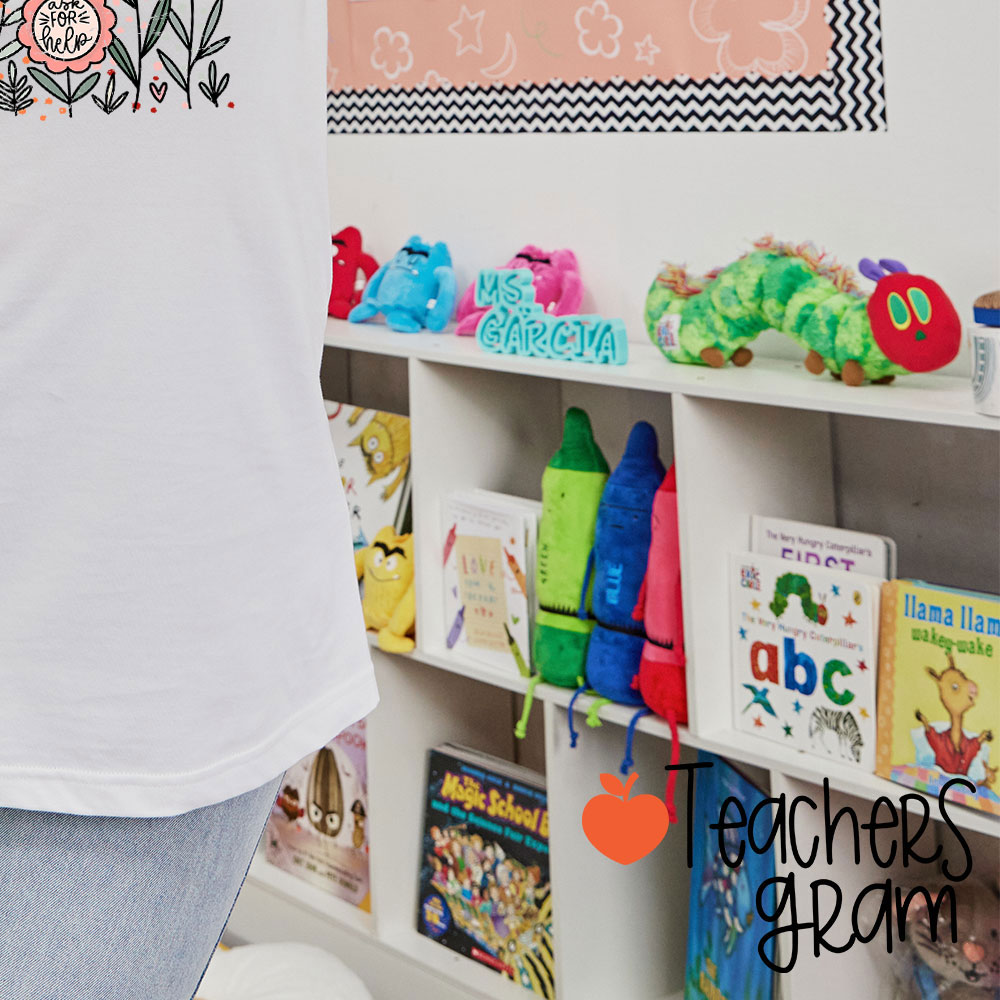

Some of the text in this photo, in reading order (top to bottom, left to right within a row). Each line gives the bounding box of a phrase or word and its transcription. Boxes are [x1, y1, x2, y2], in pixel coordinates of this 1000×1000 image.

[39, 25, 92, 54] help
[50, 11, 77, 27] FOR
[477, 308, 622, 365] GARCIA
[462, 554, 496, 577] LOVE
[904, 593, 1000, 638] llama llam
[750, 637, 856, 706] abc
[441, 772, 486, 811] Magic
[487, 789, 541, 833] School
